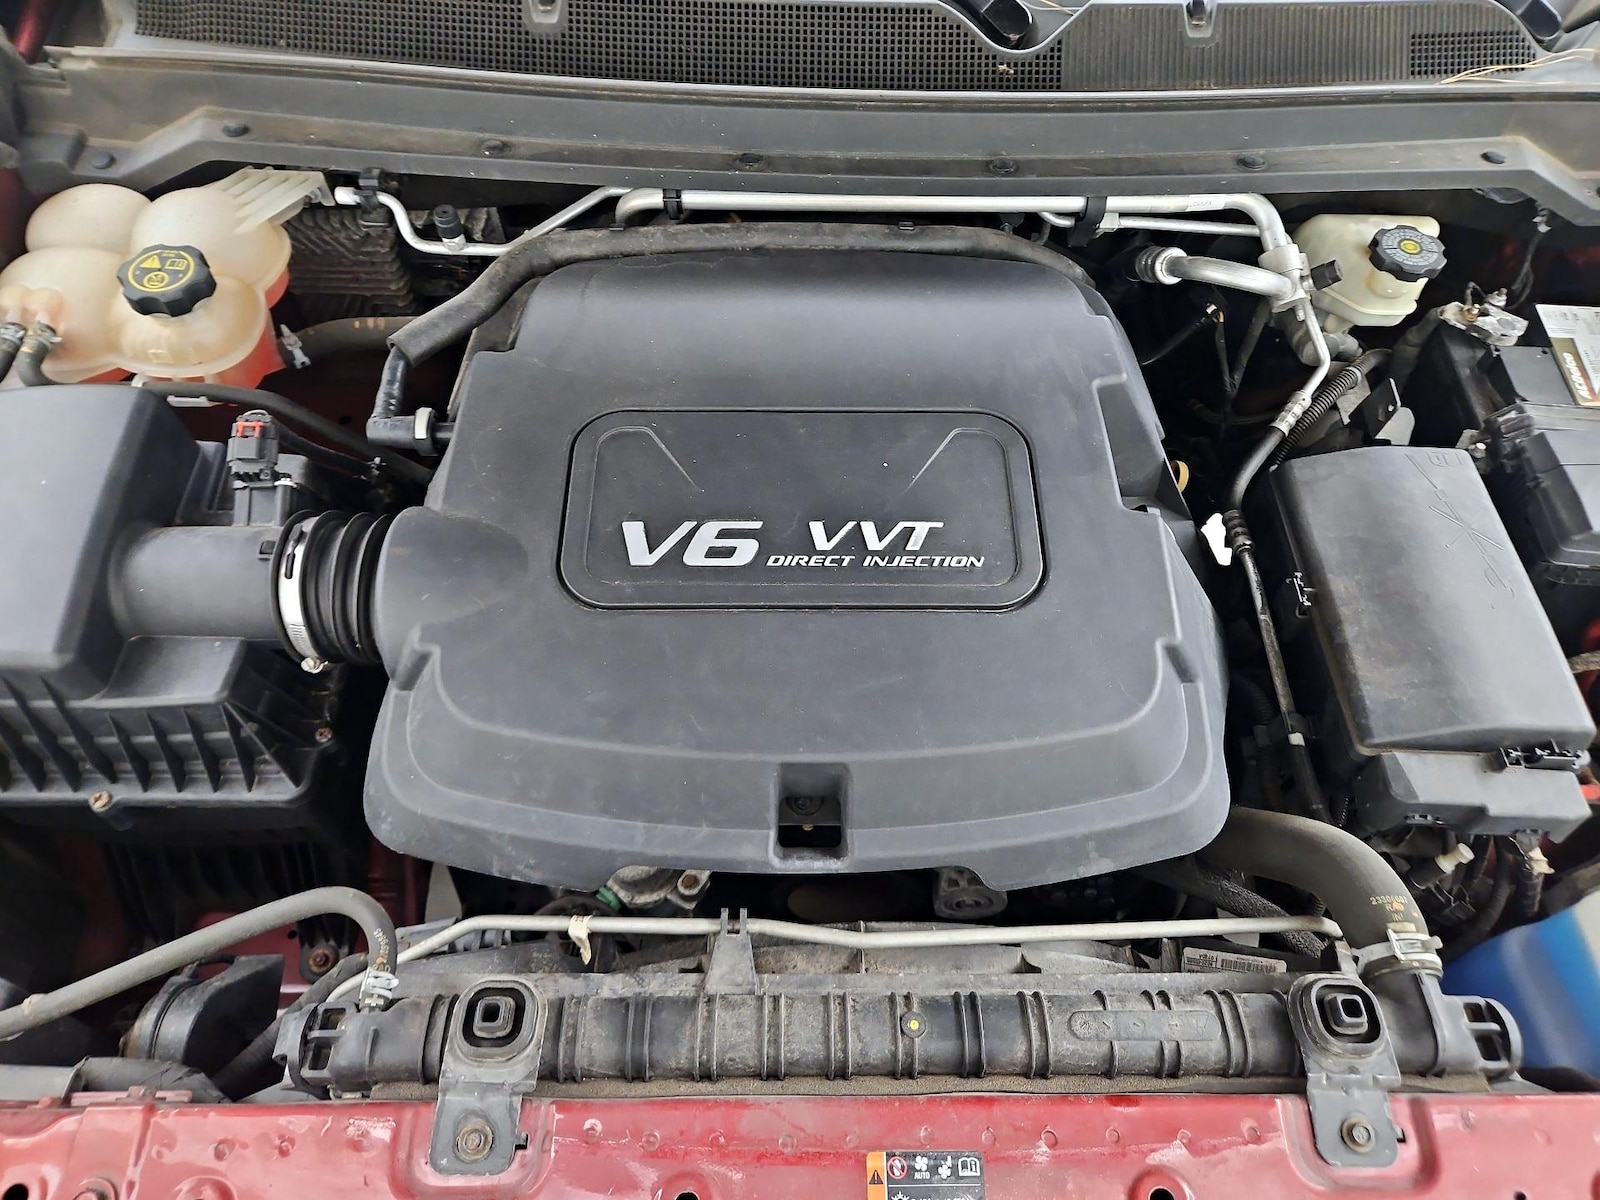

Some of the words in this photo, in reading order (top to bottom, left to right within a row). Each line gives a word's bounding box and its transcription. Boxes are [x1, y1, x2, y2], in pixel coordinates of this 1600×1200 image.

[621, 520, 764, 568] V6
[808, 520, 944, 551] VVT
[765, 555, 855, 567] DIRECT
[862, 555, 985, 568] INJECTION
[914, 1171, 931, 1180] AUTO
